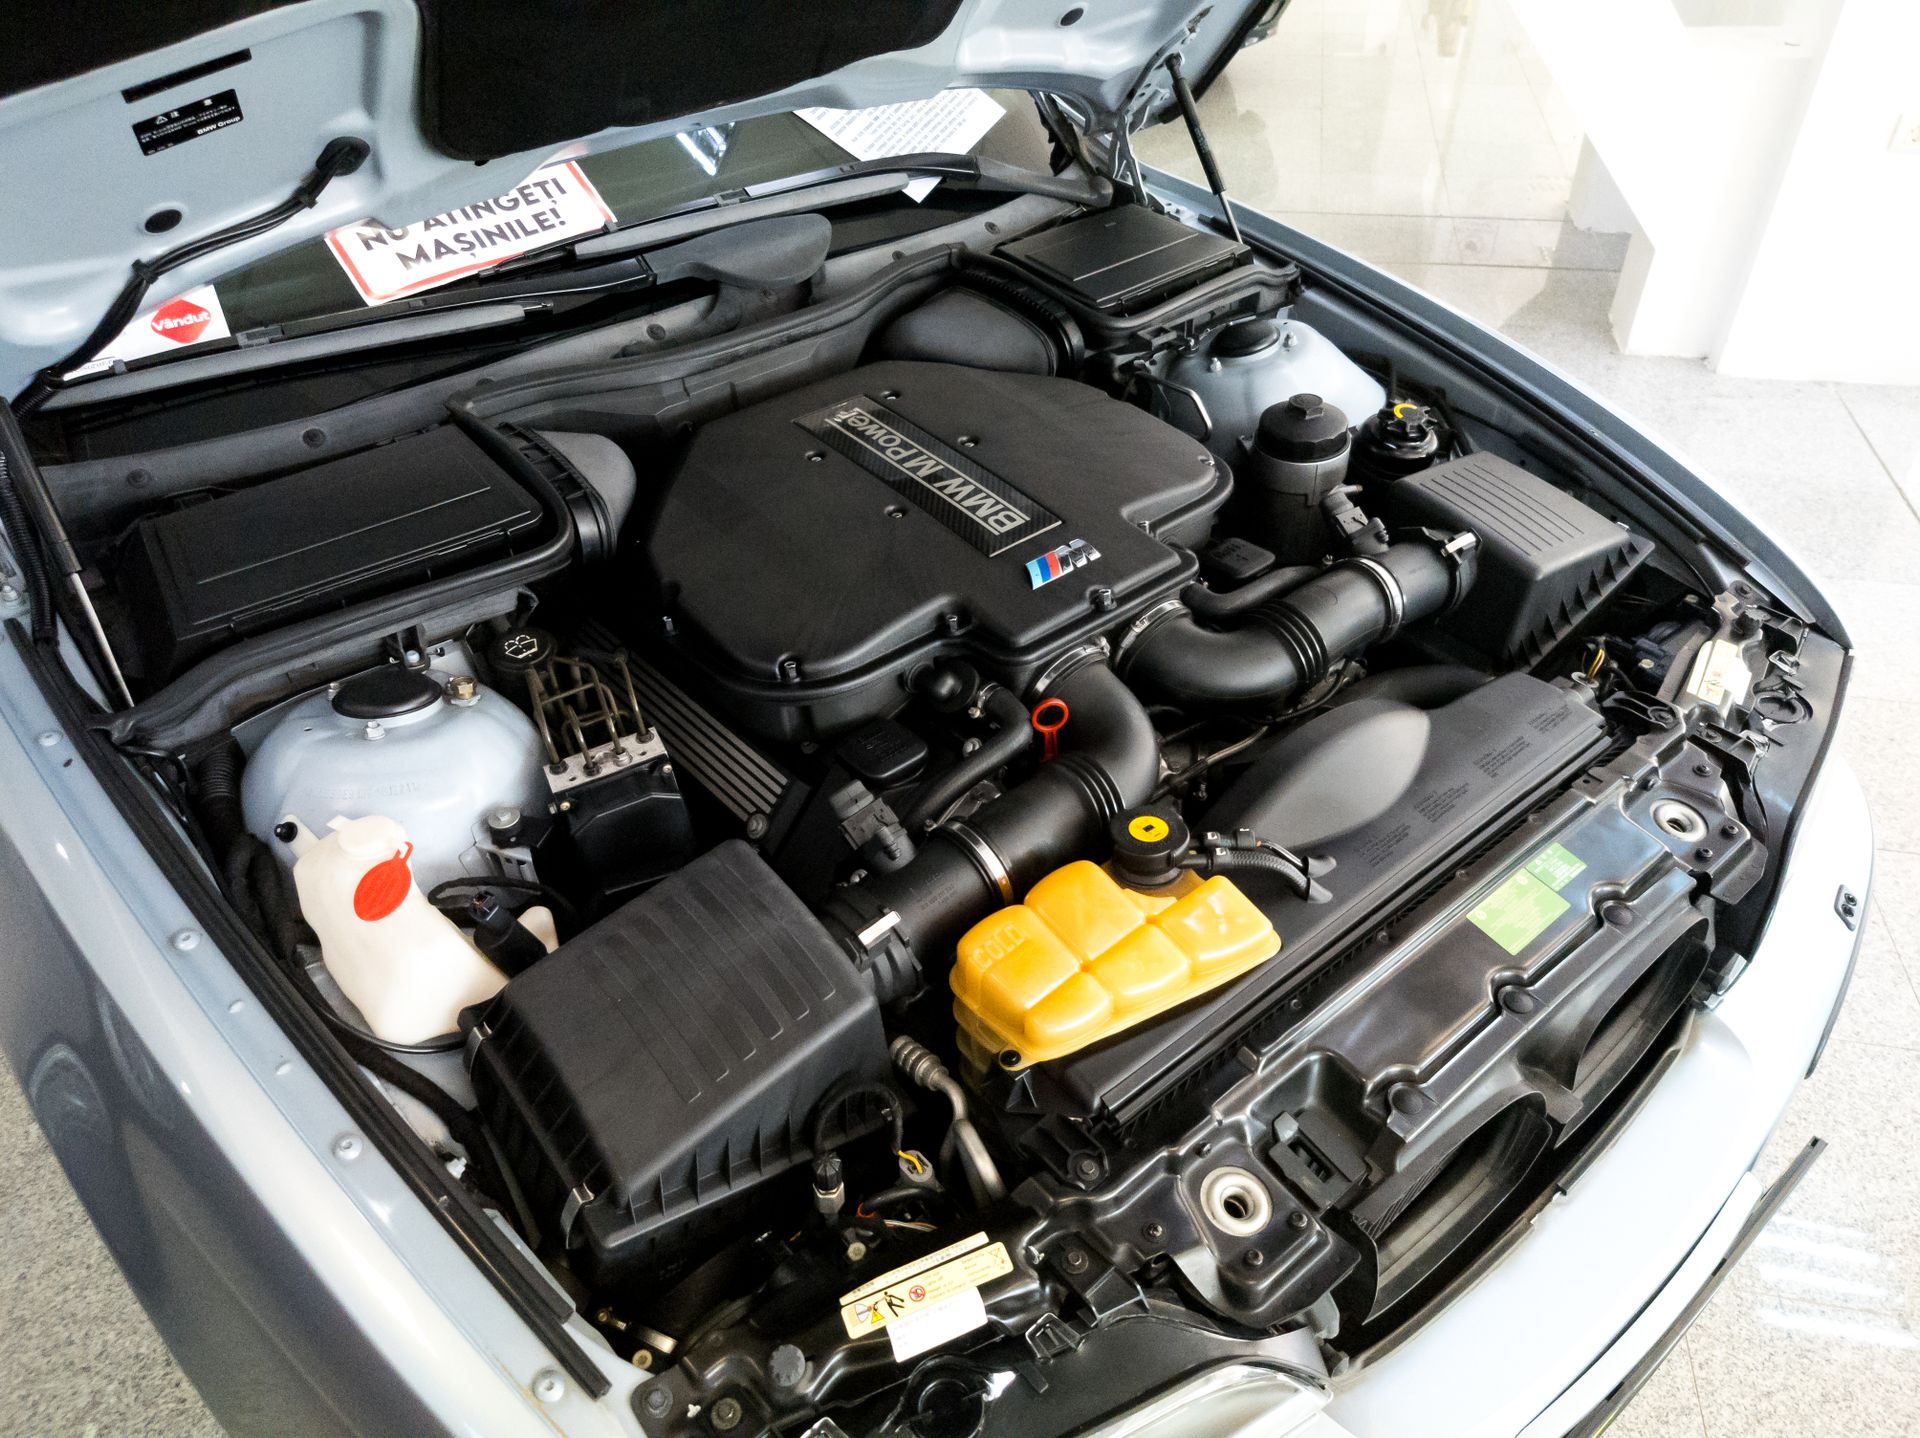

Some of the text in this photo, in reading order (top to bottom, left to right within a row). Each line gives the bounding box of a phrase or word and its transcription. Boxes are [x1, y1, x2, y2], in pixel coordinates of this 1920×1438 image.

[197, 116, 241, 135] BMW Group
[395, 208, 567, 271] MAȘINILE!
[151, 310, 211, 332] Vândut
[933, 476, 1026, 534] BMW
